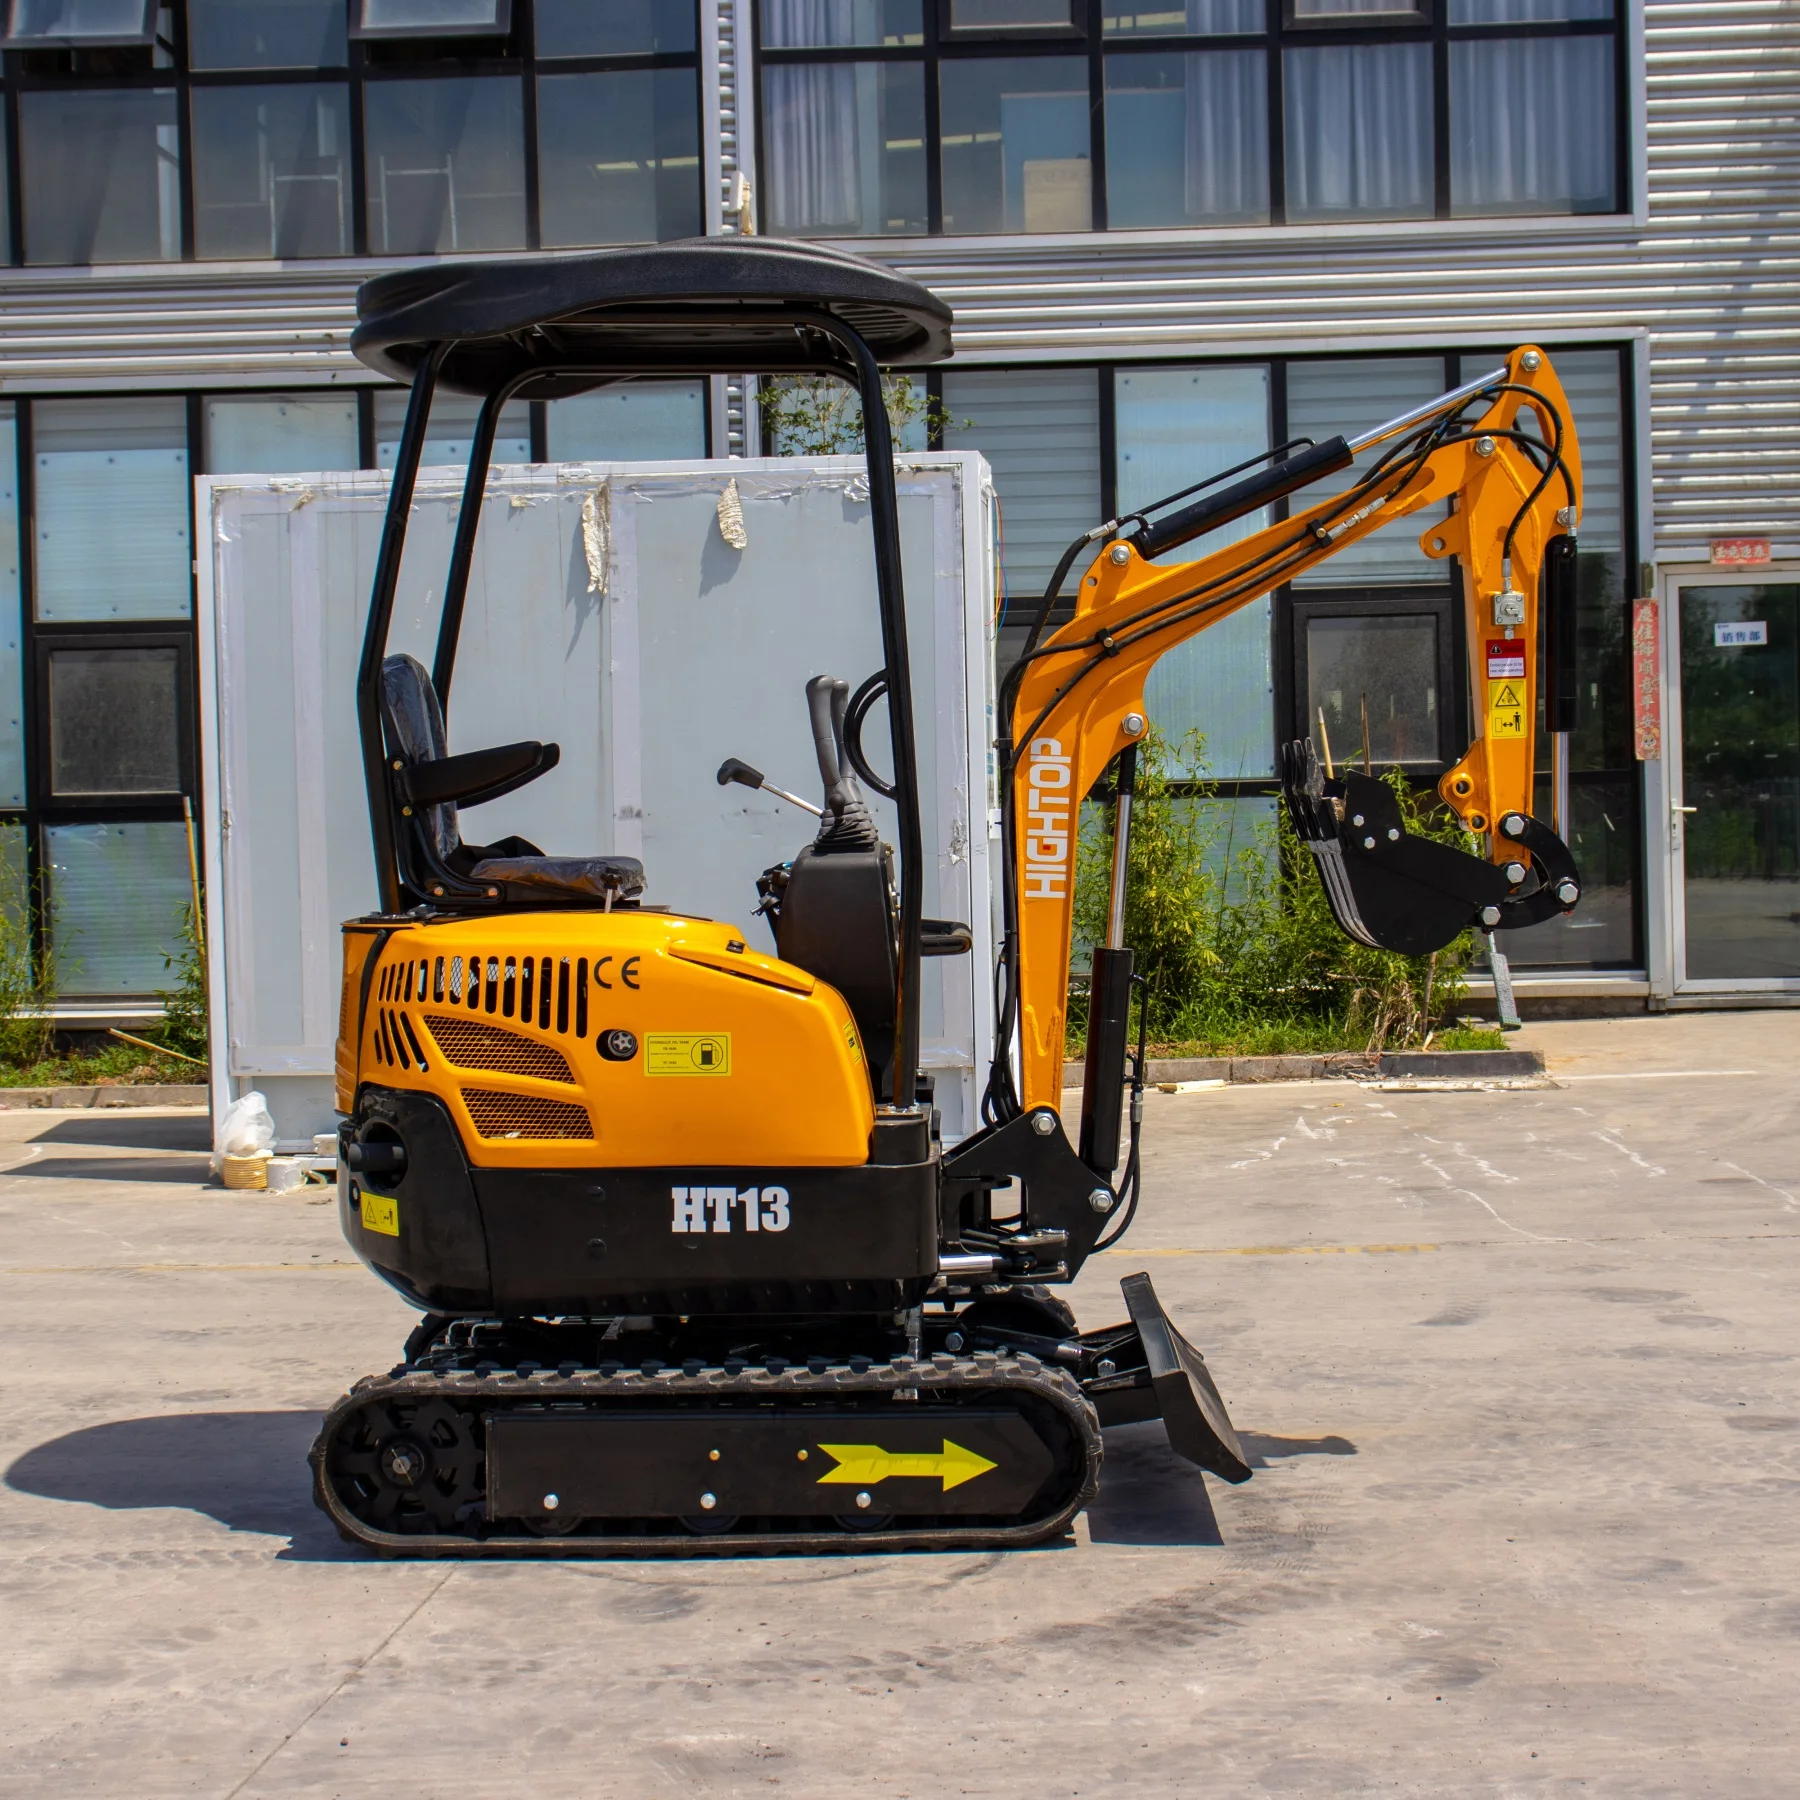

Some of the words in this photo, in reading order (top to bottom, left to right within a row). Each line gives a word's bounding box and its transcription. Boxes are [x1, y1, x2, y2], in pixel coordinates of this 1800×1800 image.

[1722, 630, 1761, 643] 销售部
[1025, 738, 1071, 898] HIGHTOP
[594, 956, 640, 990] CE
[671, 1186, 790, 1232] HT13
